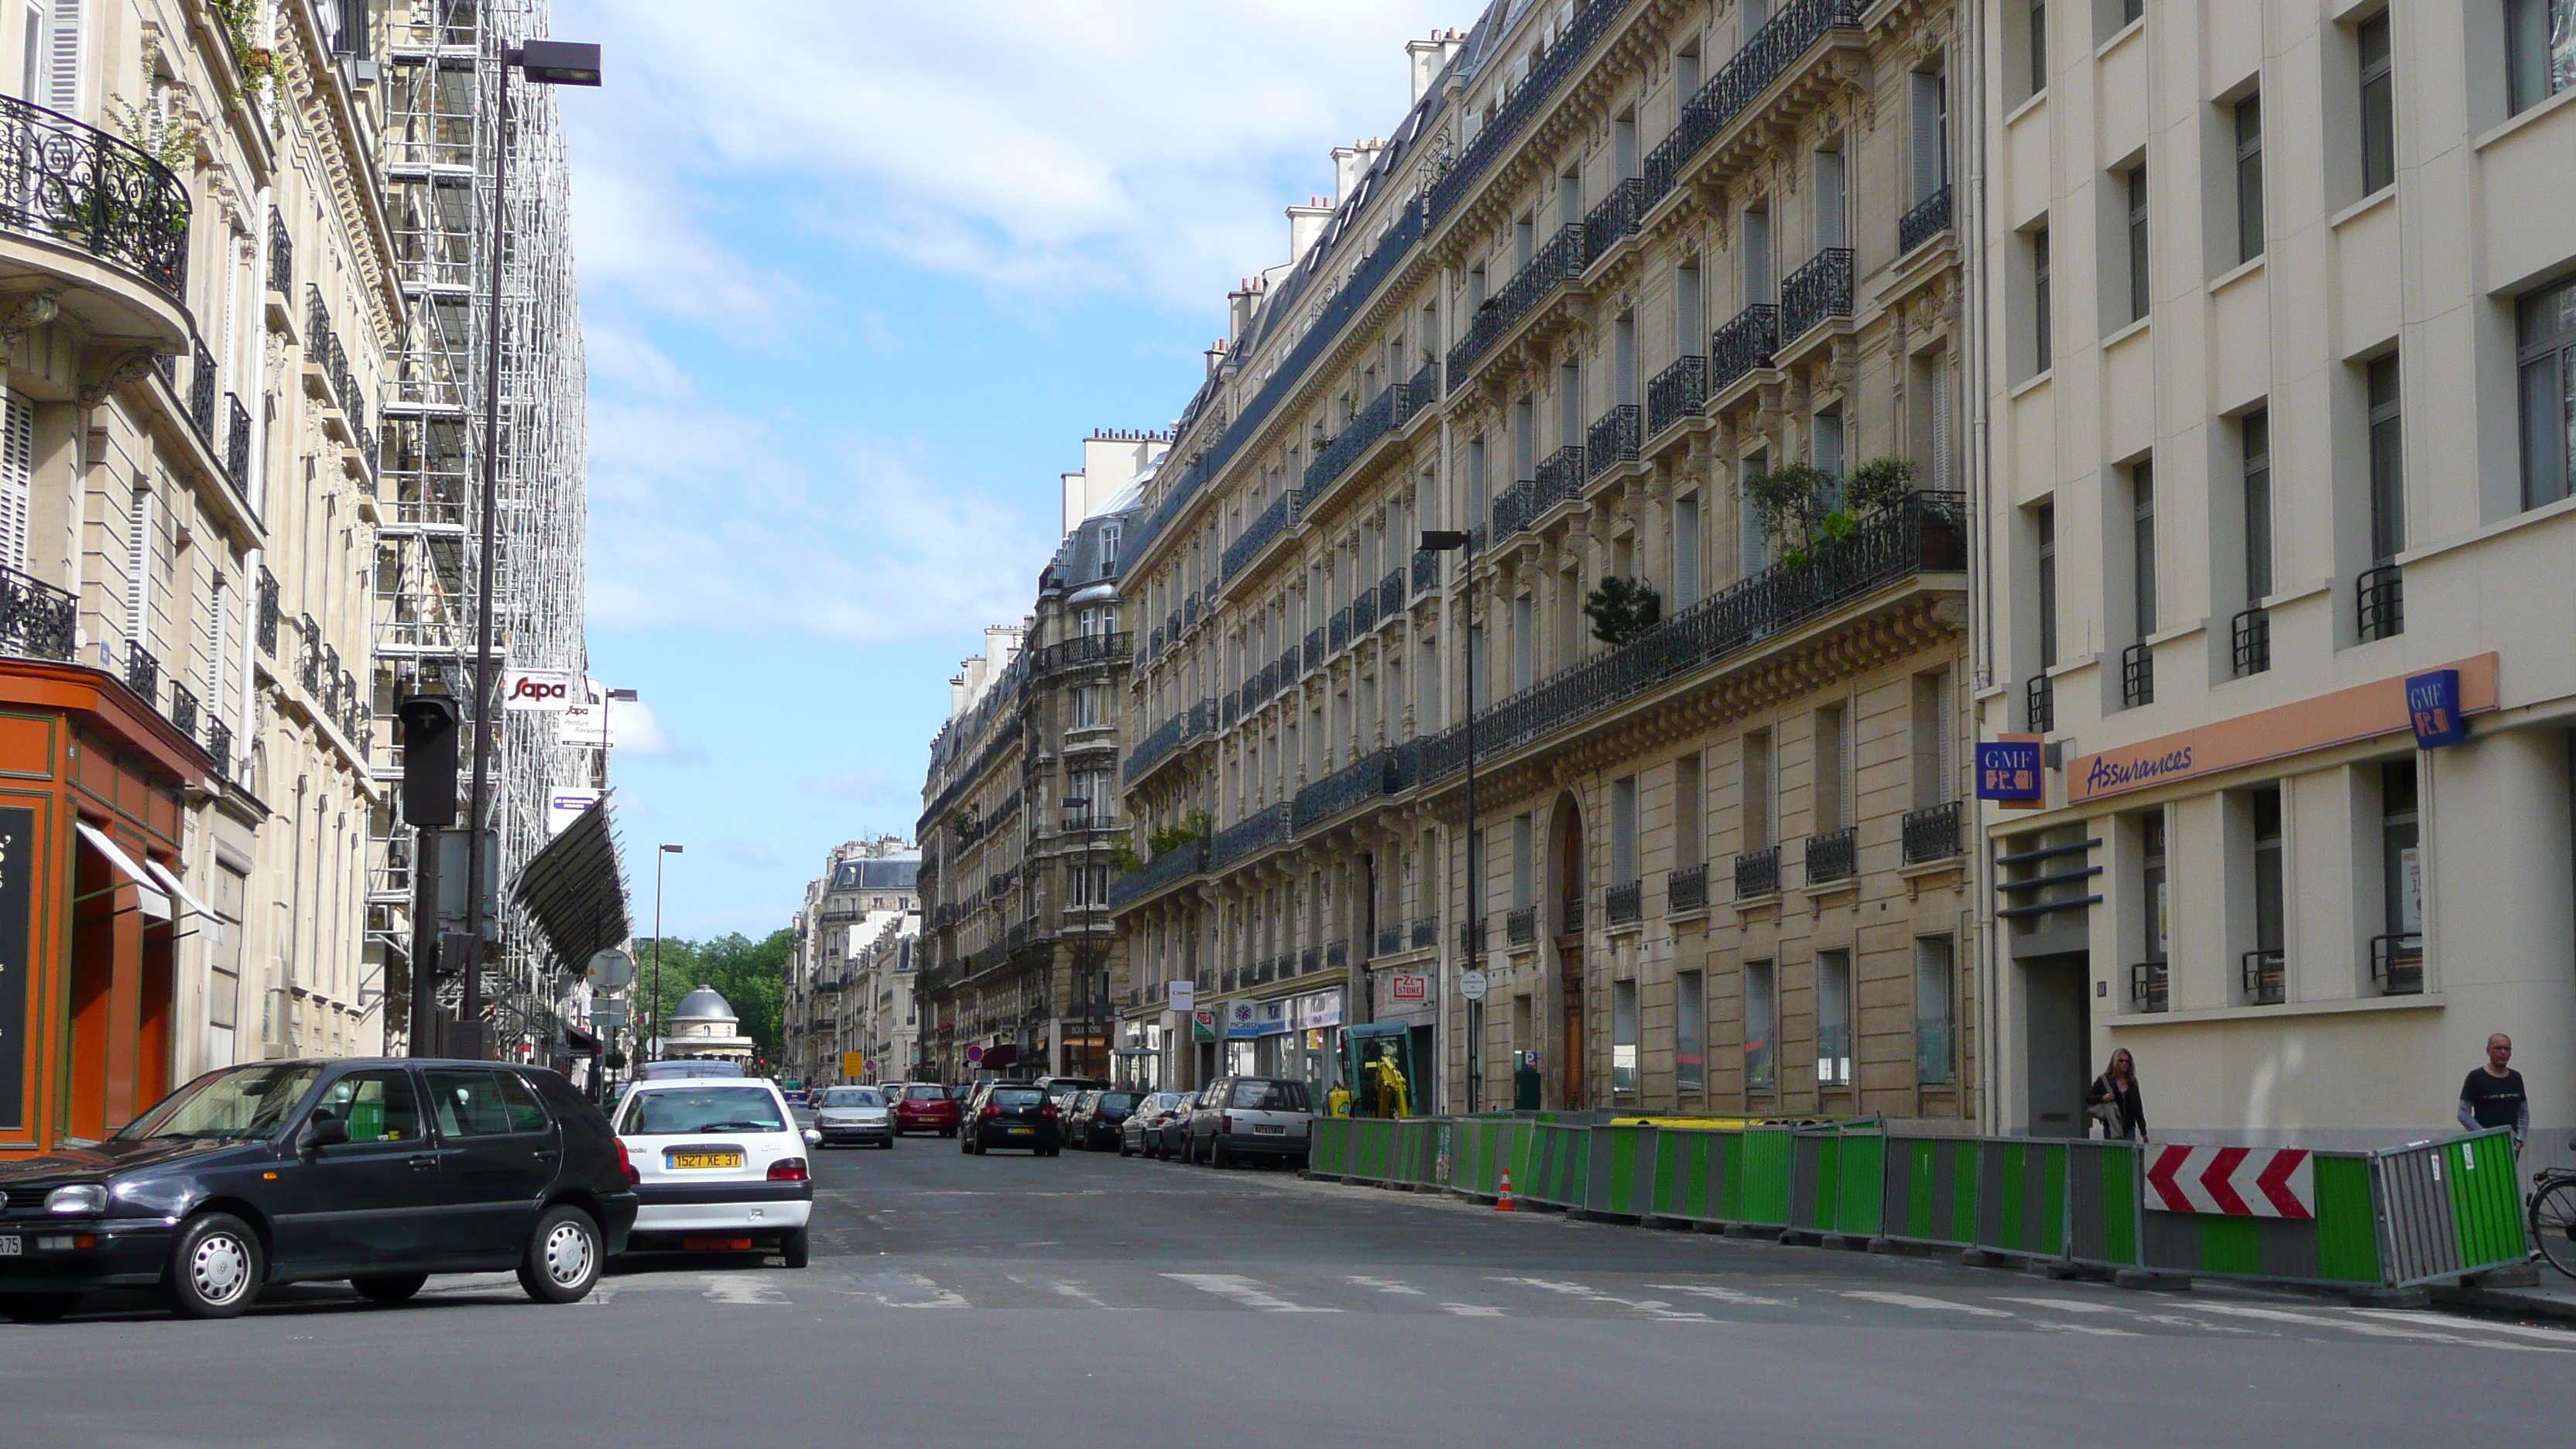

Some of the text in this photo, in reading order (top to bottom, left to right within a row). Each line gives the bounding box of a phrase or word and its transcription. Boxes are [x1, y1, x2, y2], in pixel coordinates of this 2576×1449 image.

[508, 676, 567, 702] Sapa
[2411, 683, 2441, 711] GMF
[565, 705, 589, 716] Sapa
[574, 726, 615, 735] Ravalemets
[1985, 750, 2033, 769] GMF
[2087, 745, 2193, 796] Assurances
[1397, 986, 1421, 995] STORE
[1526, 1053, 1535, 1064] P
[677, 1154, 738, 1166] 1527 XE 37
